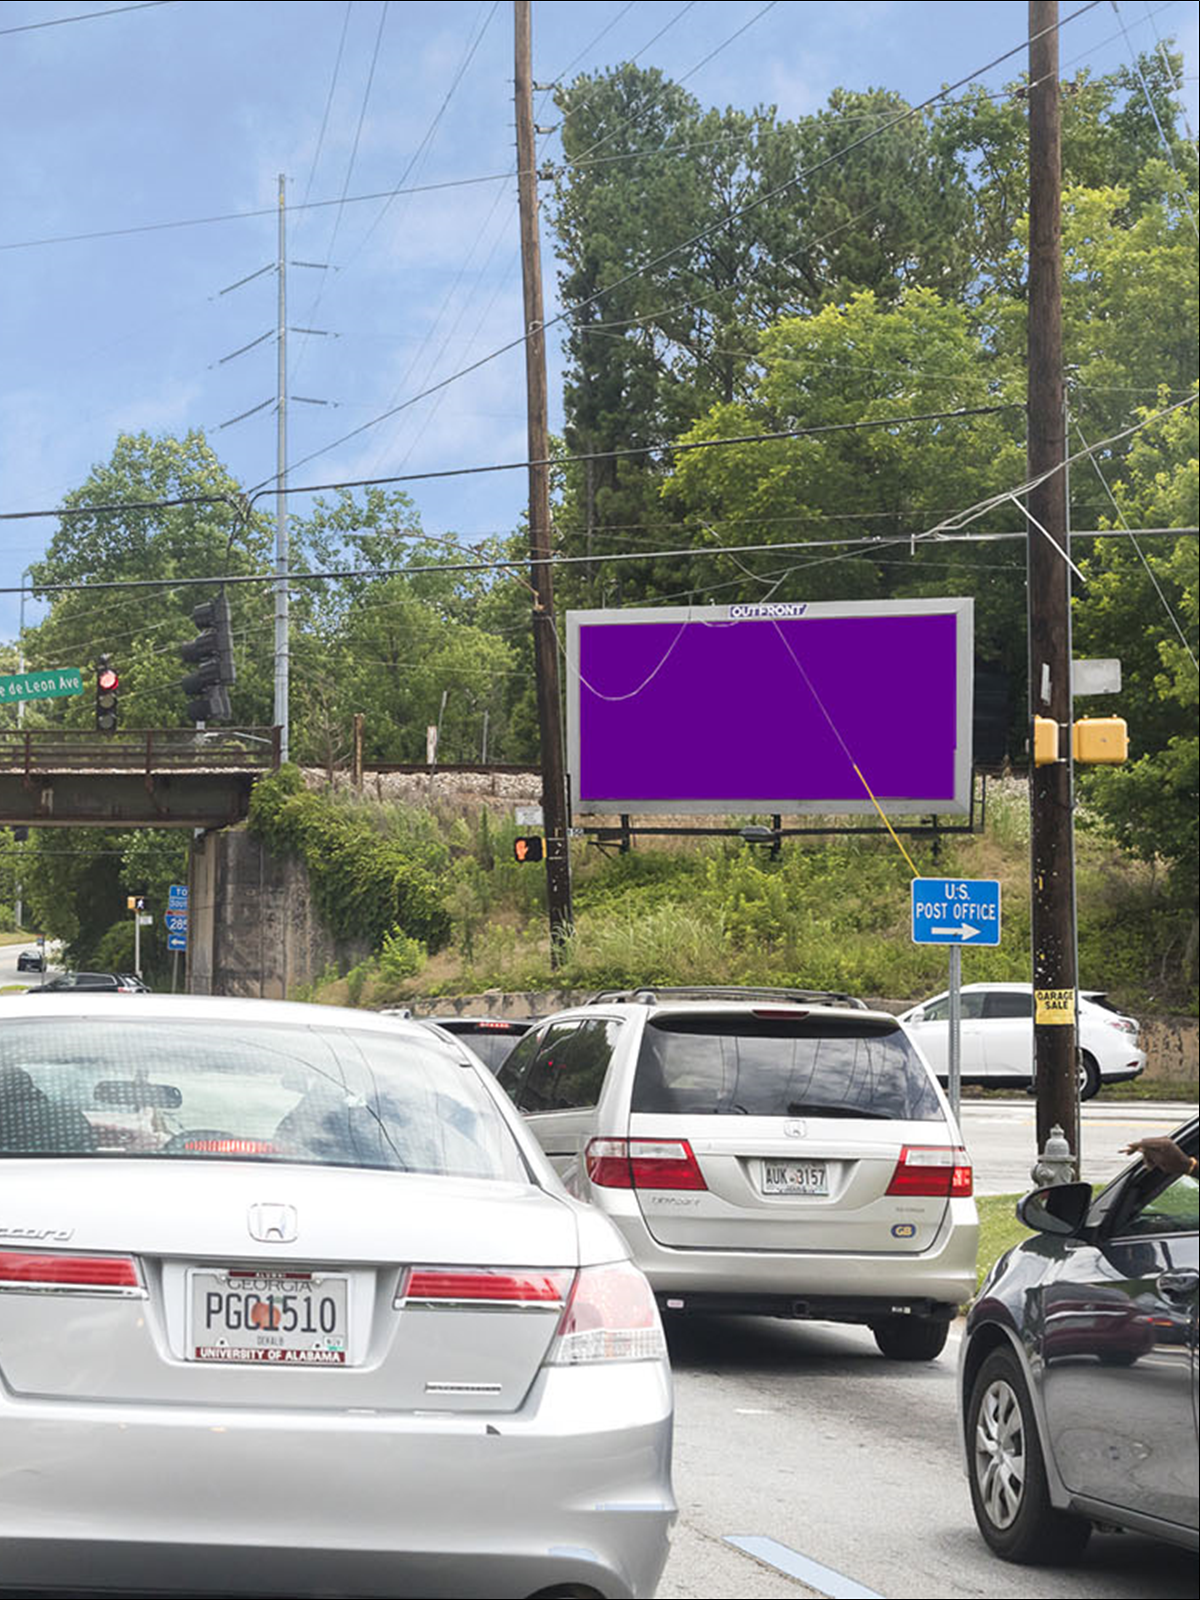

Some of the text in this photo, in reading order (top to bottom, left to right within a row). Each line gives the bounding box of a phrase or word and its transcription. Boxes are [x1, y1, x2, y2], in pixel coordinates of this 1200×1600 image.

[730, 603, 808, 618] OUTFRONT
[9, 682, 23, 695] de
[25, 680, 56, 693] Leon
[59, 677, 80, 690] Ave
[944, 883, 971, 900] U.S.
[916, 902, 996, 921] POST OFFICE
[1037, 991, 1074, 1001] GARAGE
[1045, 1001, 1068, 1010] SALE
[796, 1168, 826, 1186] 3157
[226, 1279, 313, 1293] GEORGIA
[205, 1291, 337, 1333] PGC1510
[200, 1347, 341, 1362] UNIVERSITY OF ALABAMA
